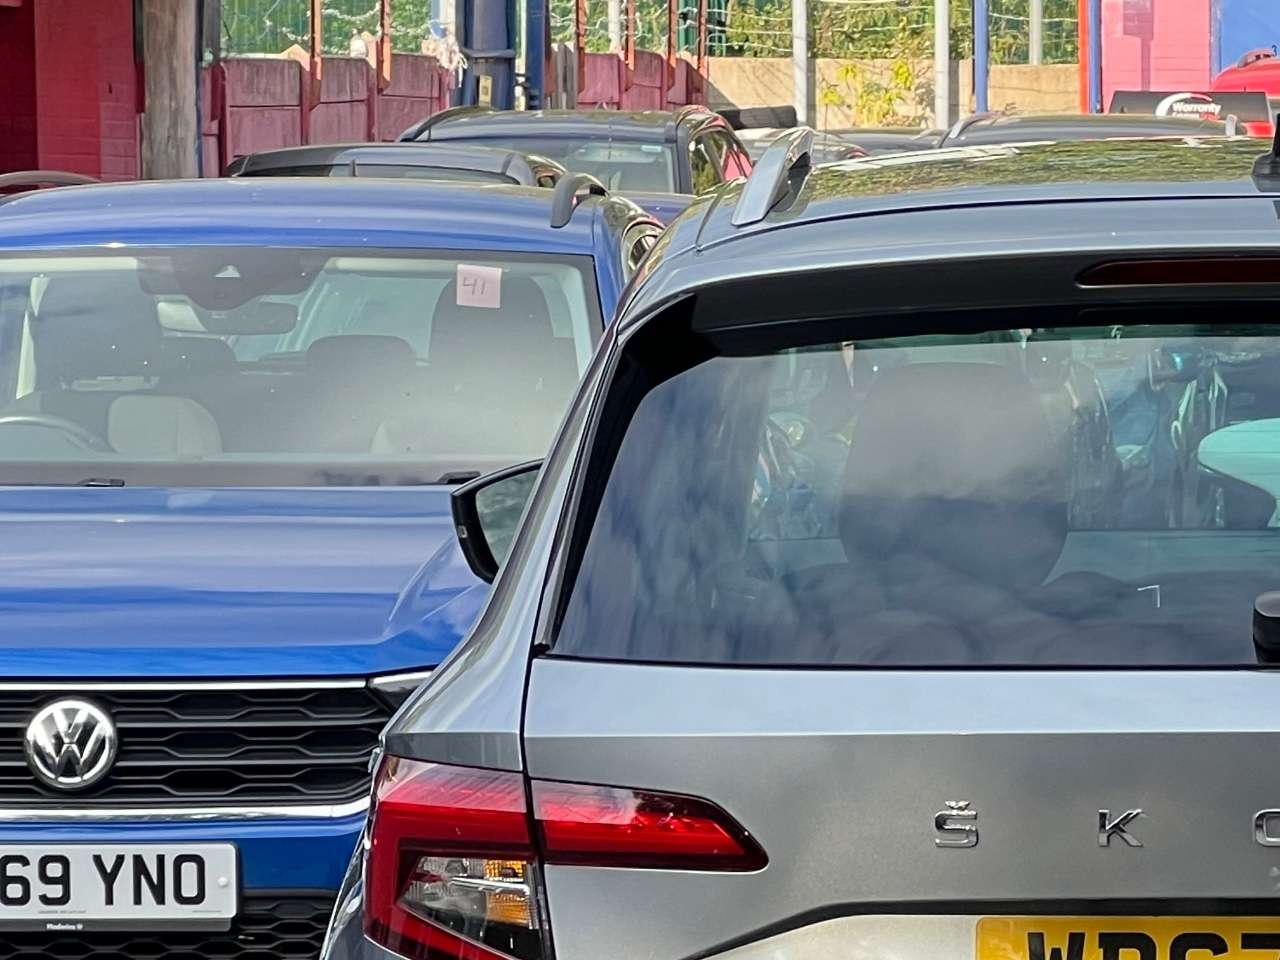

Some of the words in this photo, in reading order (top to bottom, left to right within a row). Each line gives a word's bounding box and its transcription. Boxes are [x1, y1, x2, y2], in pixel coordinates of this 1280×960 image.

[1172, 101, 1222, 114] Warranty
[462, 276, 487, 296] 41
[0, 854, 71, 906] 69
[92, 854, 206, 906] YNO
